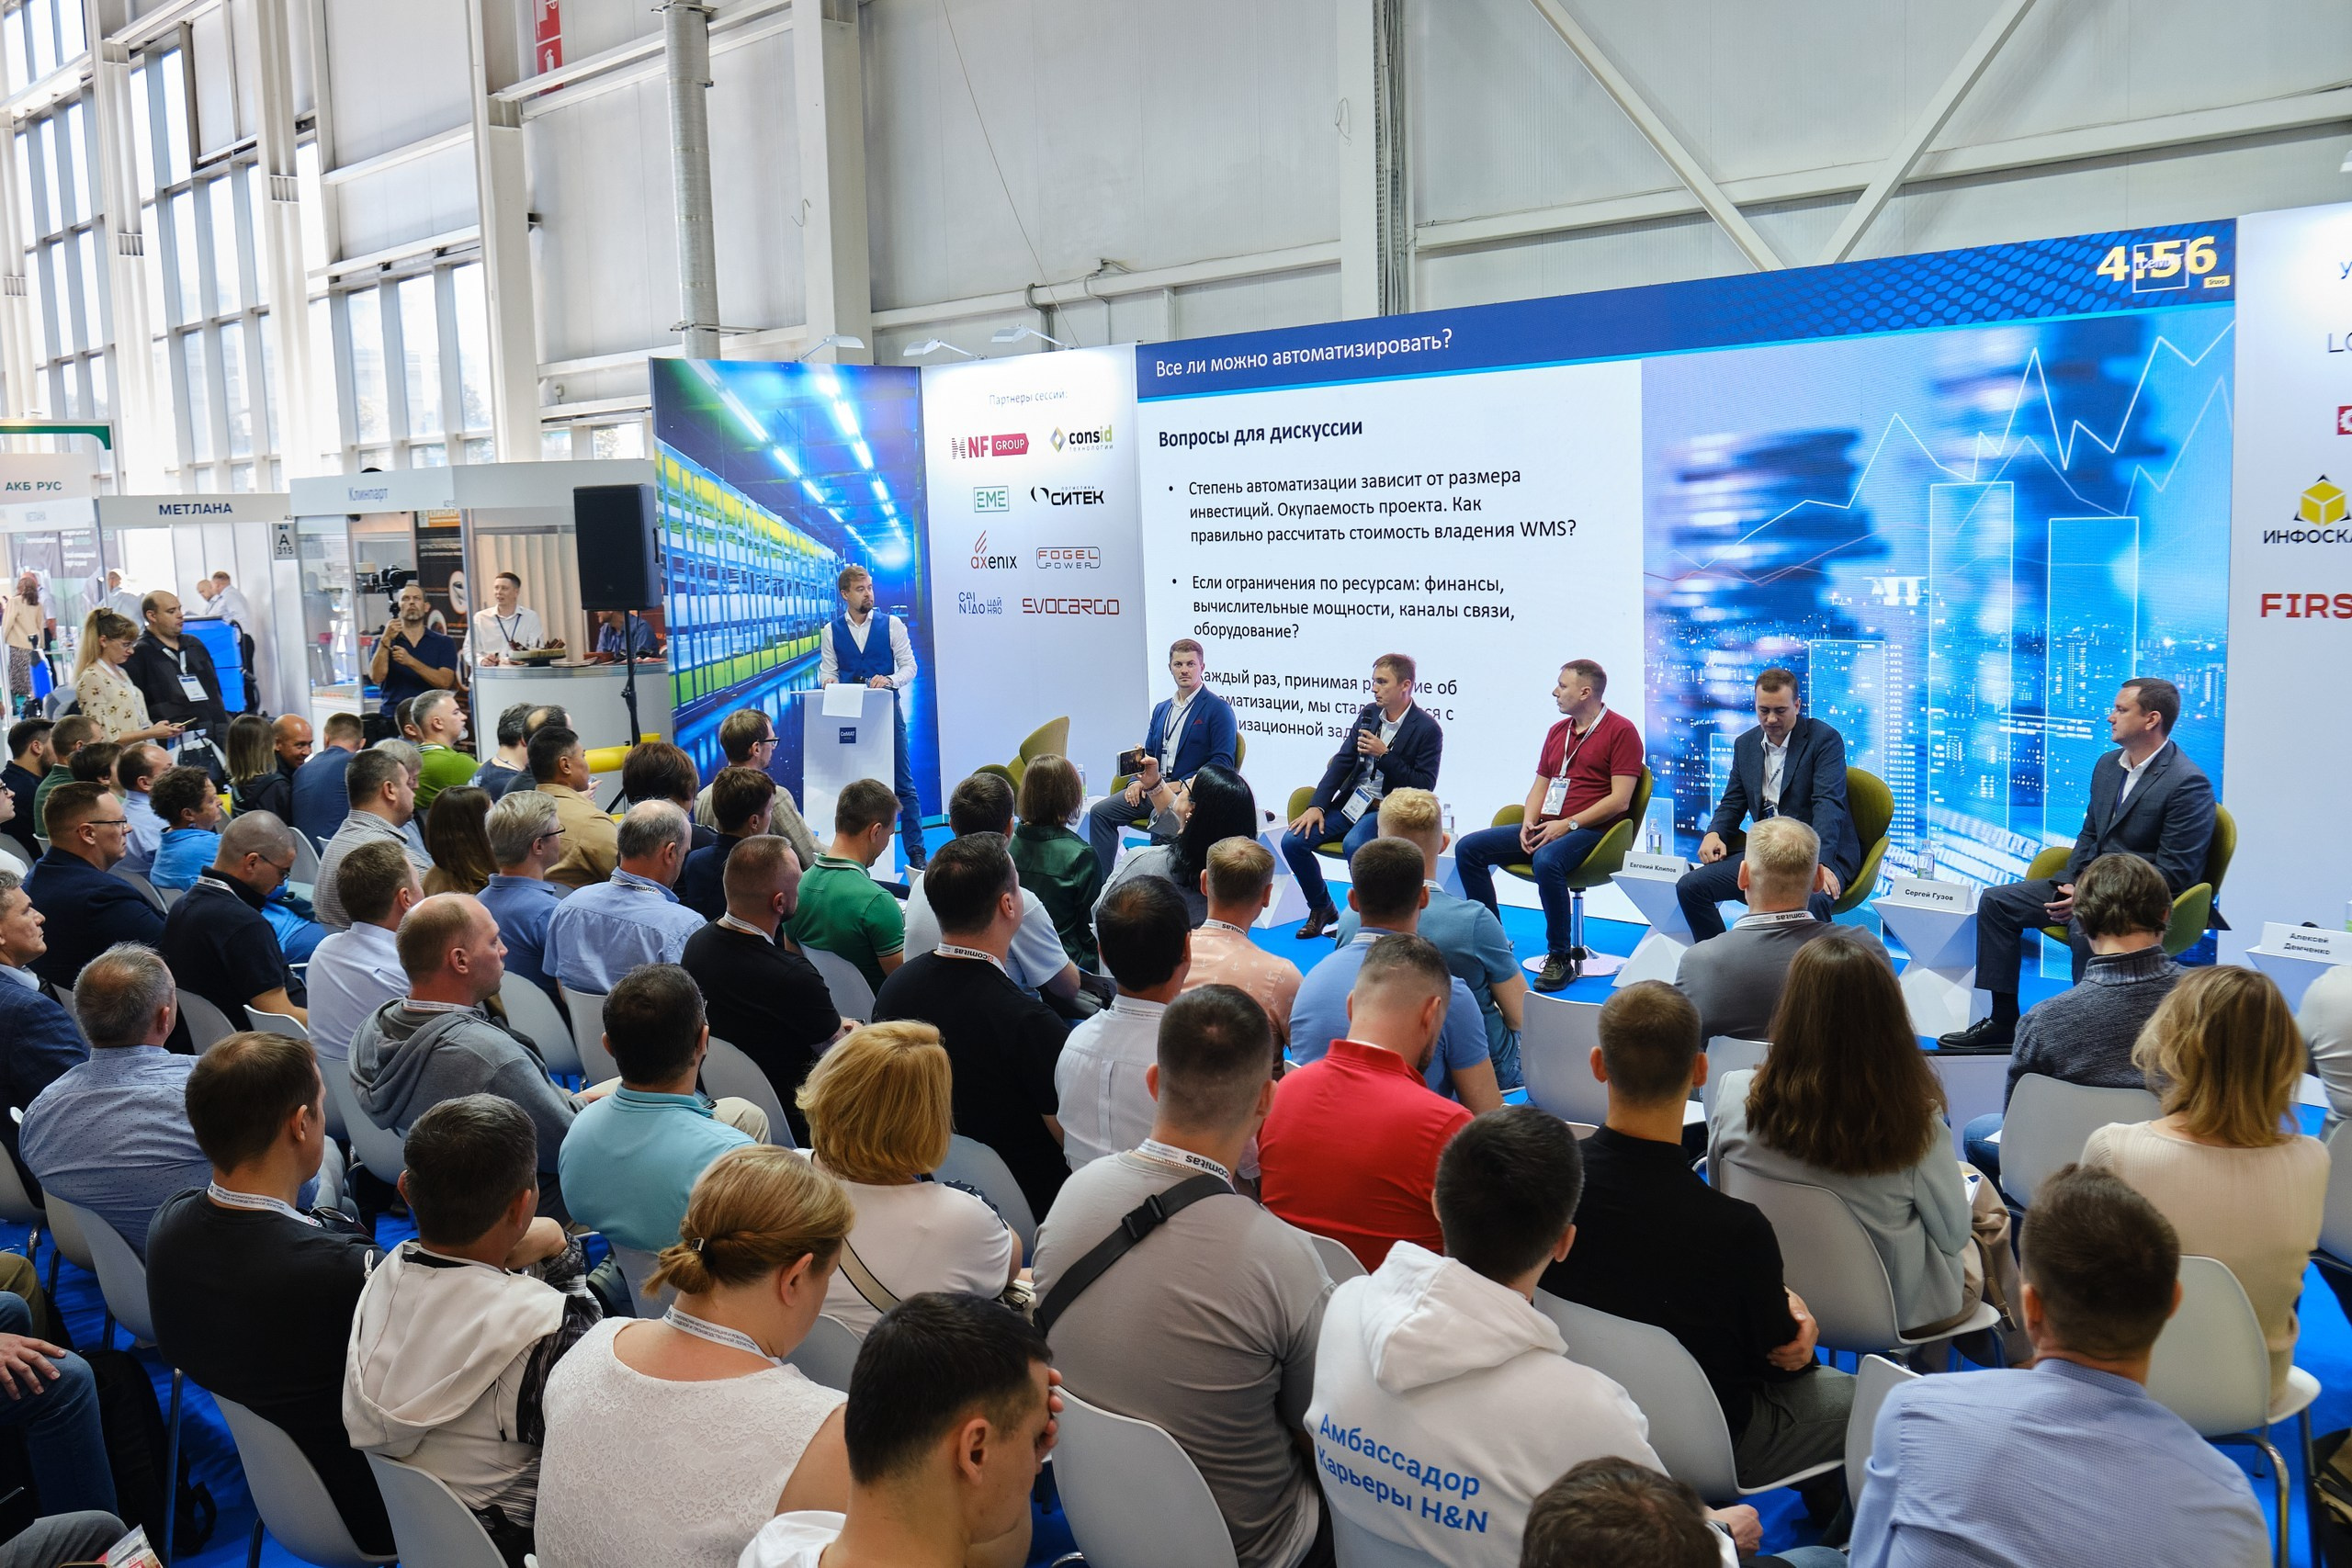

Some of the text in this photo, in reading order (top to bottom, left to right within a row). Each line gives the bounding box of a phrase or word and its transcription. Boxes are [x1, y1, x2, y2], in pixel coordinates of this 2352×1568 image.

[2097, 236, 2217, 281] 4:56
[1156, 328, 1453, 378] Все ли можно автоматизировать?
[989, 393, 1033, 407] Партнеры
[1069, 424, 1113, 445] consid
[1159, 421, 1363, 450] Вопросы для дискуссии
[968, 435, 1025, 457] NF GROUP
[6, 481, 62, 491] АКБ РУС
[1189, 470, 1521, 495] Степень автоматизации зависит от размера
[1051, 491, 1104, 505] СИТЕК
[159, 503, 233, 515] МЕТЛАНА
[1190, 496, 1482, 521] инвестиций. Окупаемость проекта. Как
[1191, 519, 1577, 546] правильно рассчитать стоимость владения WMS?
[277, 547, 294, 555] 315
[1038, 550, 1098, 560] FOGEL
[970, 556, 1018, 570] axenix
[1193, 574, 1504, 595] Если ограничения по ресурсам: финансы,
[1193, 602, 1515, 622] вычислительные мощности, каналы связи,
[1193, 621, 1299, 640] оборудование?
[1201, 669, 1250, 686] аждый
[1253, 673, 1281, 689] раз,
[1284, 675, 1358, 691] принимая
[1437, 679, 1457, 695] об
[1307, 700, 1330, 713] мы
[1445, 709, 1454, 721] с
[1630, 862, 1653, 870] Евгений
[632, 885, 655, 893] comit
[1905, 889, 1953, 901] Сергей Гузов
[2284, 942, 2330, 954] Демченко
[2290, 933, 2329, 943] Алексей
[954, 948, 988, 960] comitas
[1185, 1155, 1229, 1179] comitas
[1319, 1414, 1481, 1500] Амбассадор
[1317, 1444, 1488, 1533] Карьеры H&N
